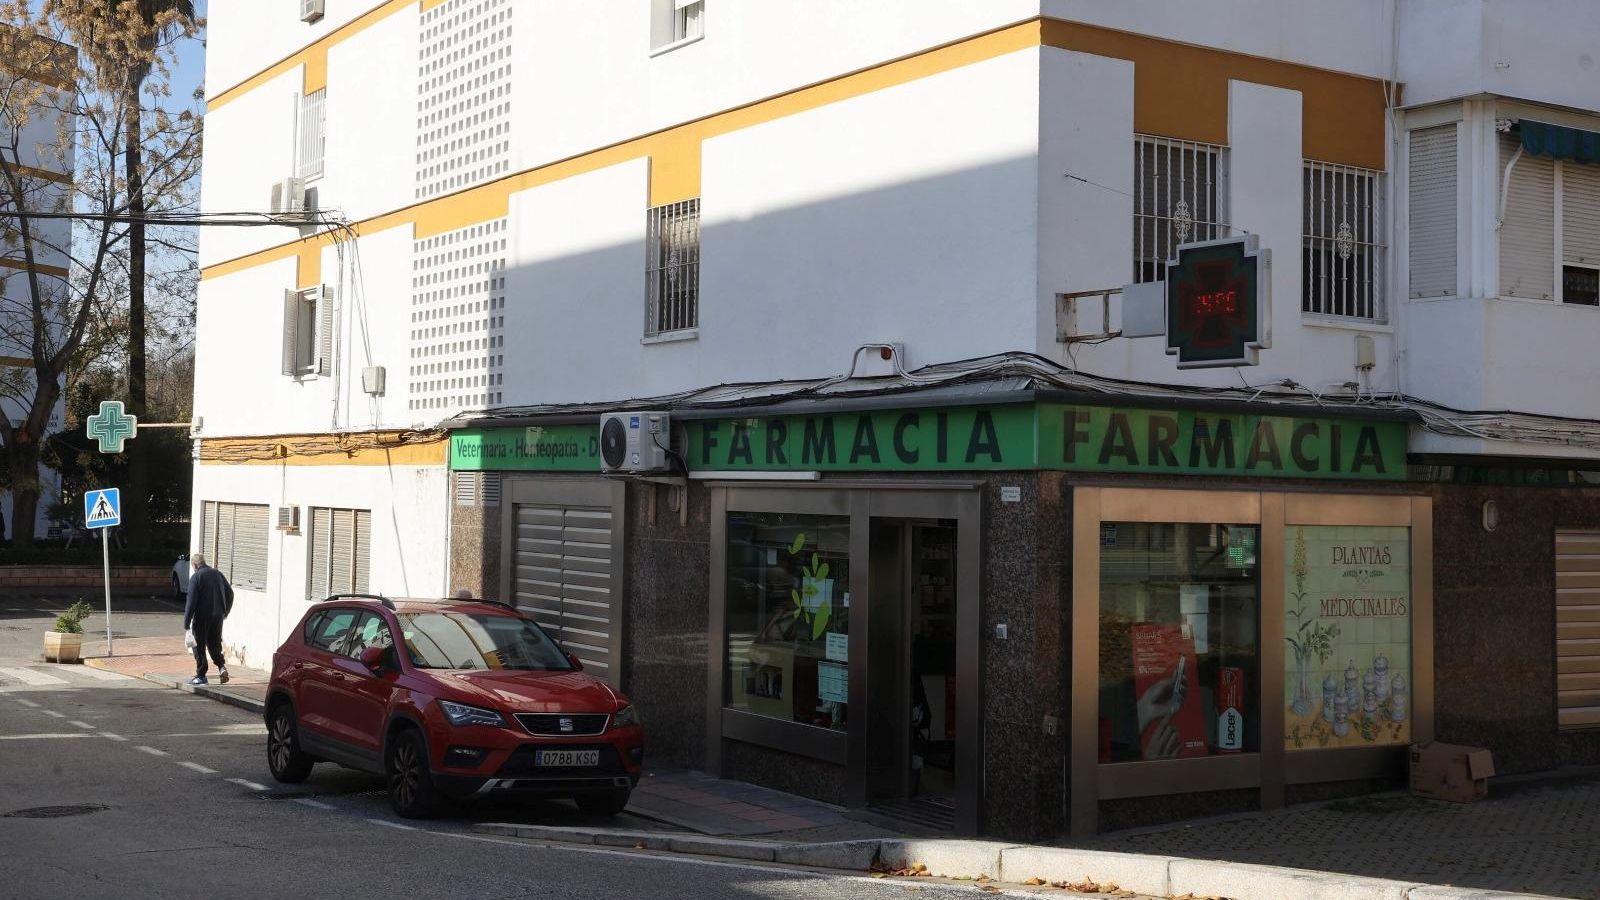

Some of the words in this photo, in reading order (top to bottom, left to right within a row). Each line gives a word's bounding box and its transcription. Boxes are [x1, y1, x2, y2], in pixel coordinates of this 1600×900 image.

[456, 438, 507, 458] Veterinaria
[703, 411, 1003, 466] FARMACIA
[1062, 410, 1387, 475] FARMACIA
[1331, 546, 1393, 565] PLANTAS
[1319, 597, 1407, 618] MEDICINALES
[1224, 711, 1236, 746] Lacer
[543, 752, 573, 765] 0788
[575, 752, 598, 765] KSC
